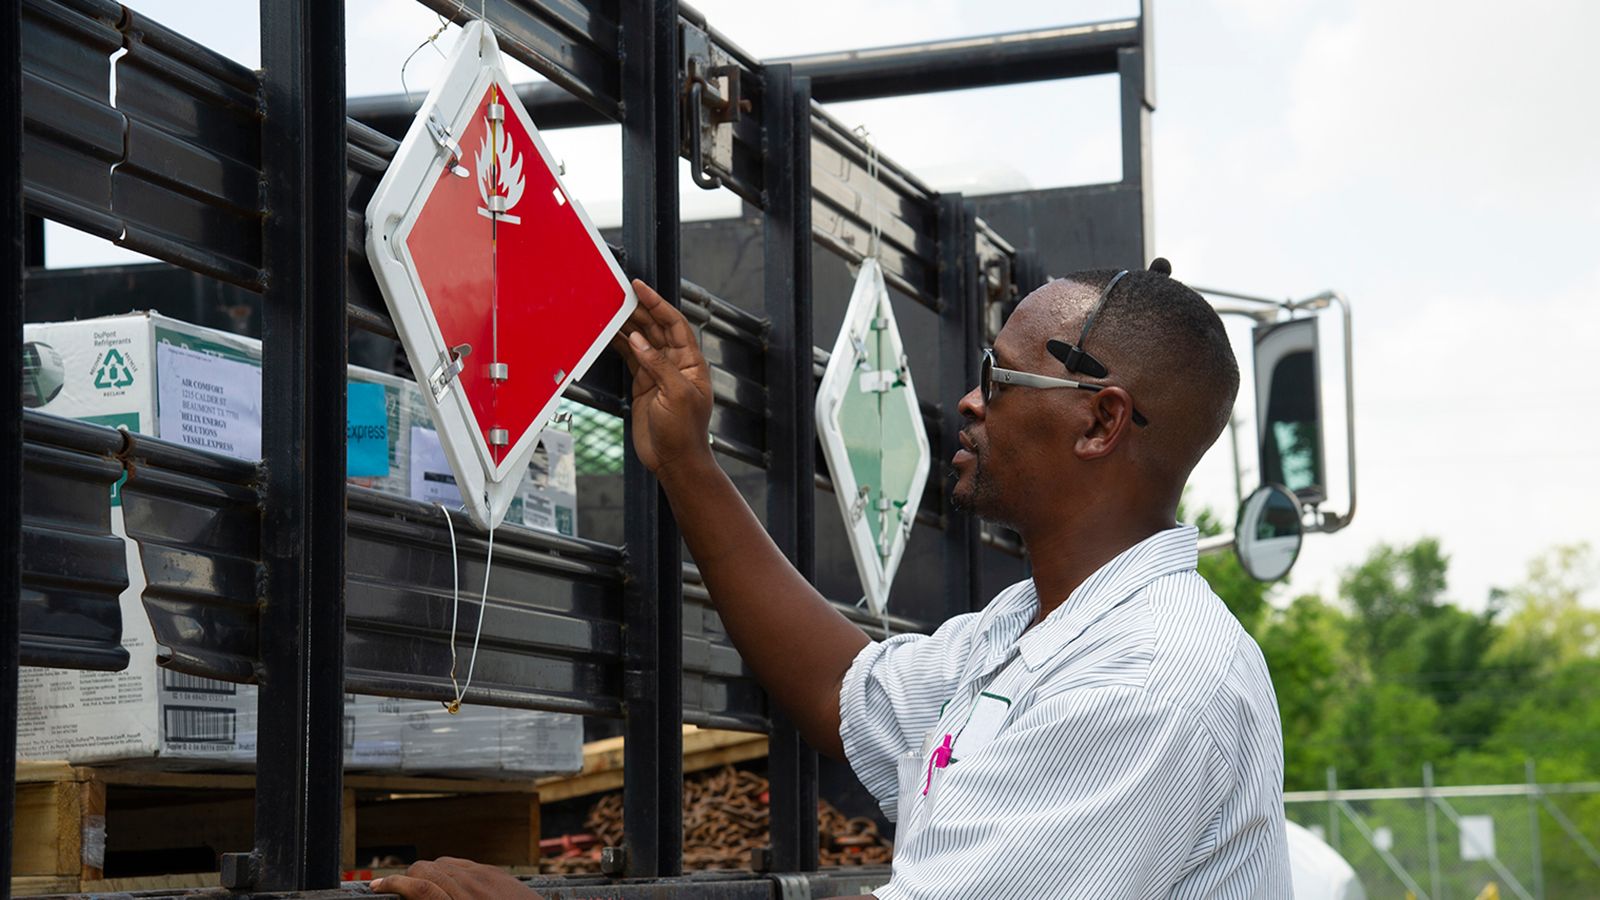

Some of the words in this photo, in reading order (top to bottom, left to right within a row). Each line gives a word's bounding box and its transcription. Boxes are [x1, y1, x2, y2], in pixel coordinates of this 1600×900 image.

[93, 331, 117, 340] DuPont
[94, 338, 132, 347] Refrigerants
[181, 378, 193, 388] AIR
[193, 380, 224, 394] COMFORT
[195, 390, 219, 405] CALDER
[219, 397, 227, 406] ST
[182, 400, 216, 415] BEAUMONT
[181, 412, 201, 423] HELIX
[201, 416, 227, 430] ENERGY
[181, 423, 218, 438] SOLUTIONS
